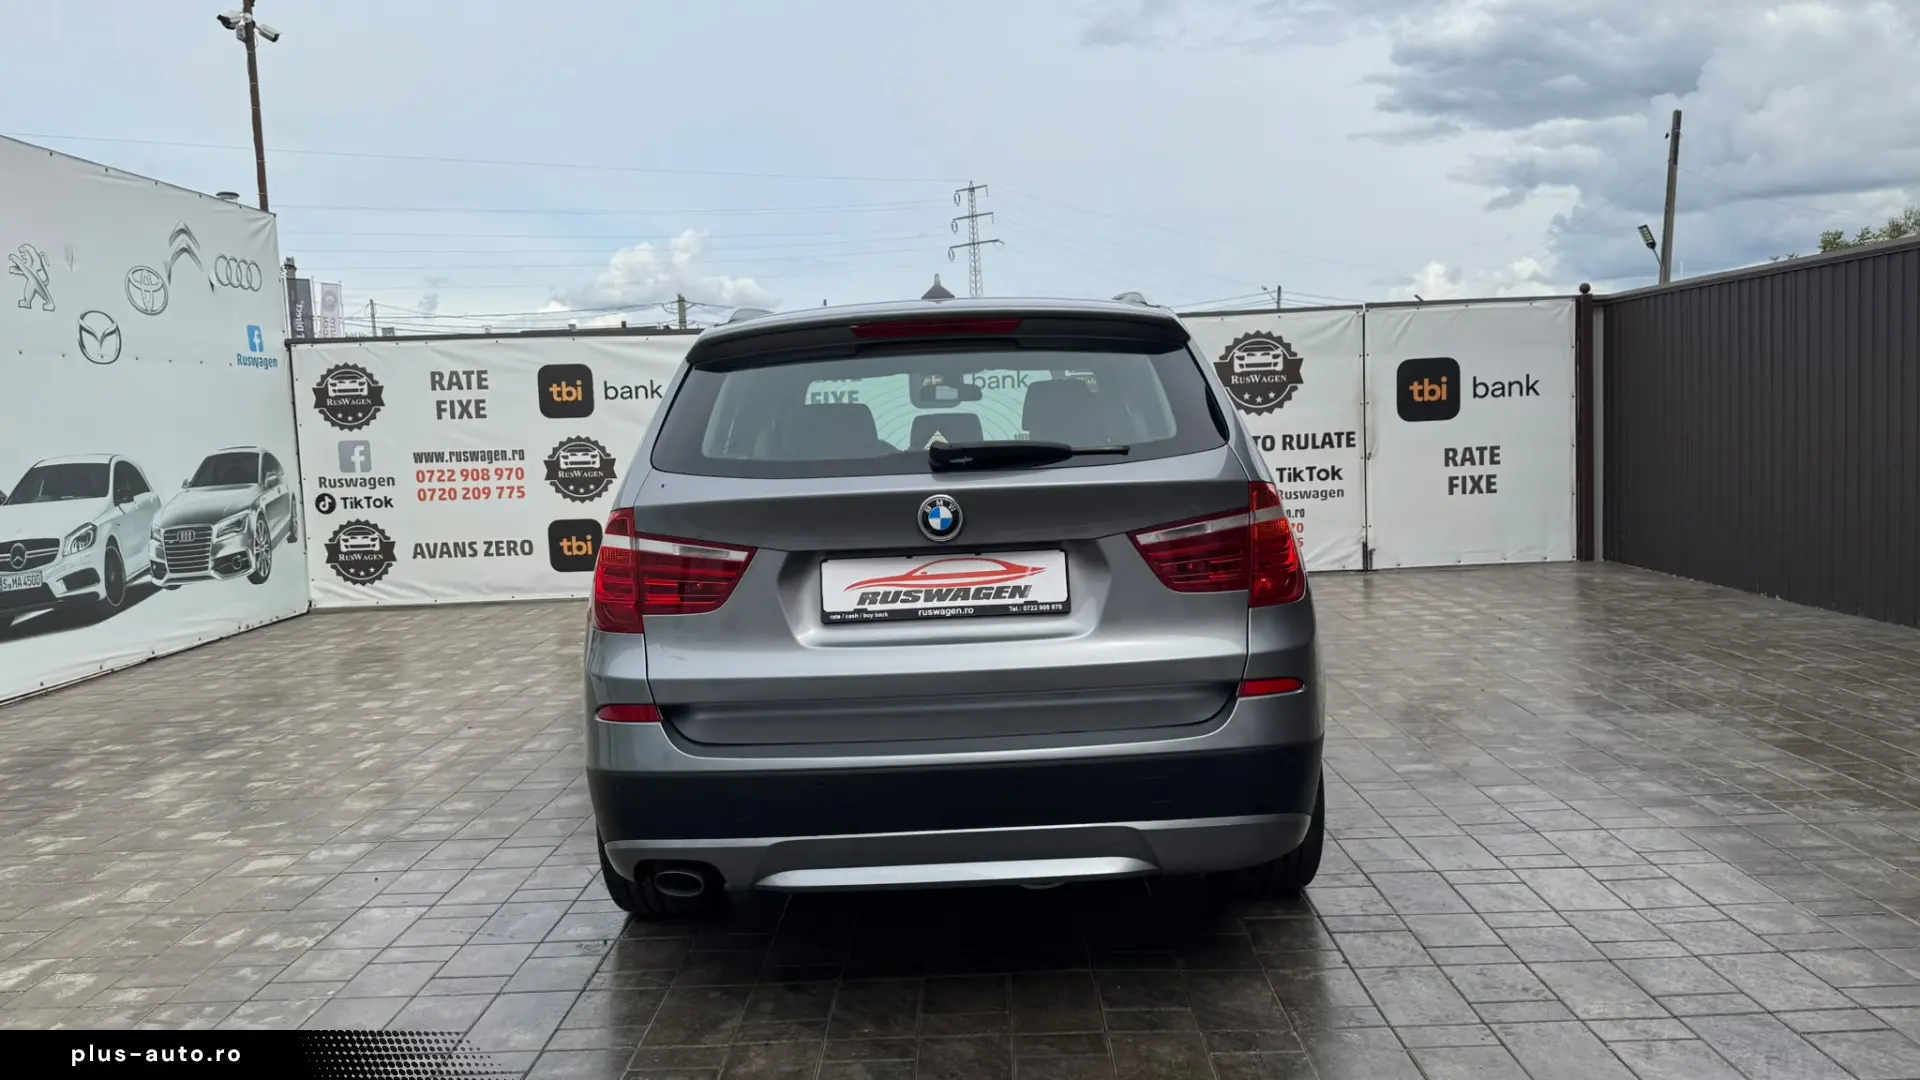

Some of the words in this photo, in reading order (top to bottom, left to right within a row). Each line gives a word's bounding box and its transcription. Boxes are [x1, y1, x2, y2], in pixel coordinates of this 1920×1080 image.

[236, 353, 278, 370] Ruswagen
[430, 370, 489, 391] RATE
[972, 370, 1029, 390] bank
[1409, 376, 1448, 402] tbi
[1472, 373, 1540, 399] bank
[549, 380, 583, 402] tbi
[603, 379, 663, 400] bank
[436, 399, 487, 420] FIXE
[1252, 434, 1276, 452] TO
[1282, 431, 1356, 451] RULATE
[412, 449, 525, 464] www.ruswagen.ro
[1444, 445, 1501, 467] RATE
[318, 476, 396, 490] Ruswagen
[416, 469, 457, 483] 0722
[460, 468, 491, 482] 908
[494, 467, 525, 481] 970
[1275, 465, 1343, 483] TikTok
[417, 487, 458, 502] 0720
[461, 486, 491, 500] 209
[495, 485, 526, 499] 775
[1448, 474, 1497, 496] FIXE
[340, 496, 394, 510] TikTok
[412, 541, 478, 559] AVANS
[483, 539, 534, 557] ZERO
[560, 534, 593, 556] tbi
[856, 585, 1032, 606] RUSWAGEN
[918, 607, 974, 617] ruswagen.ro
